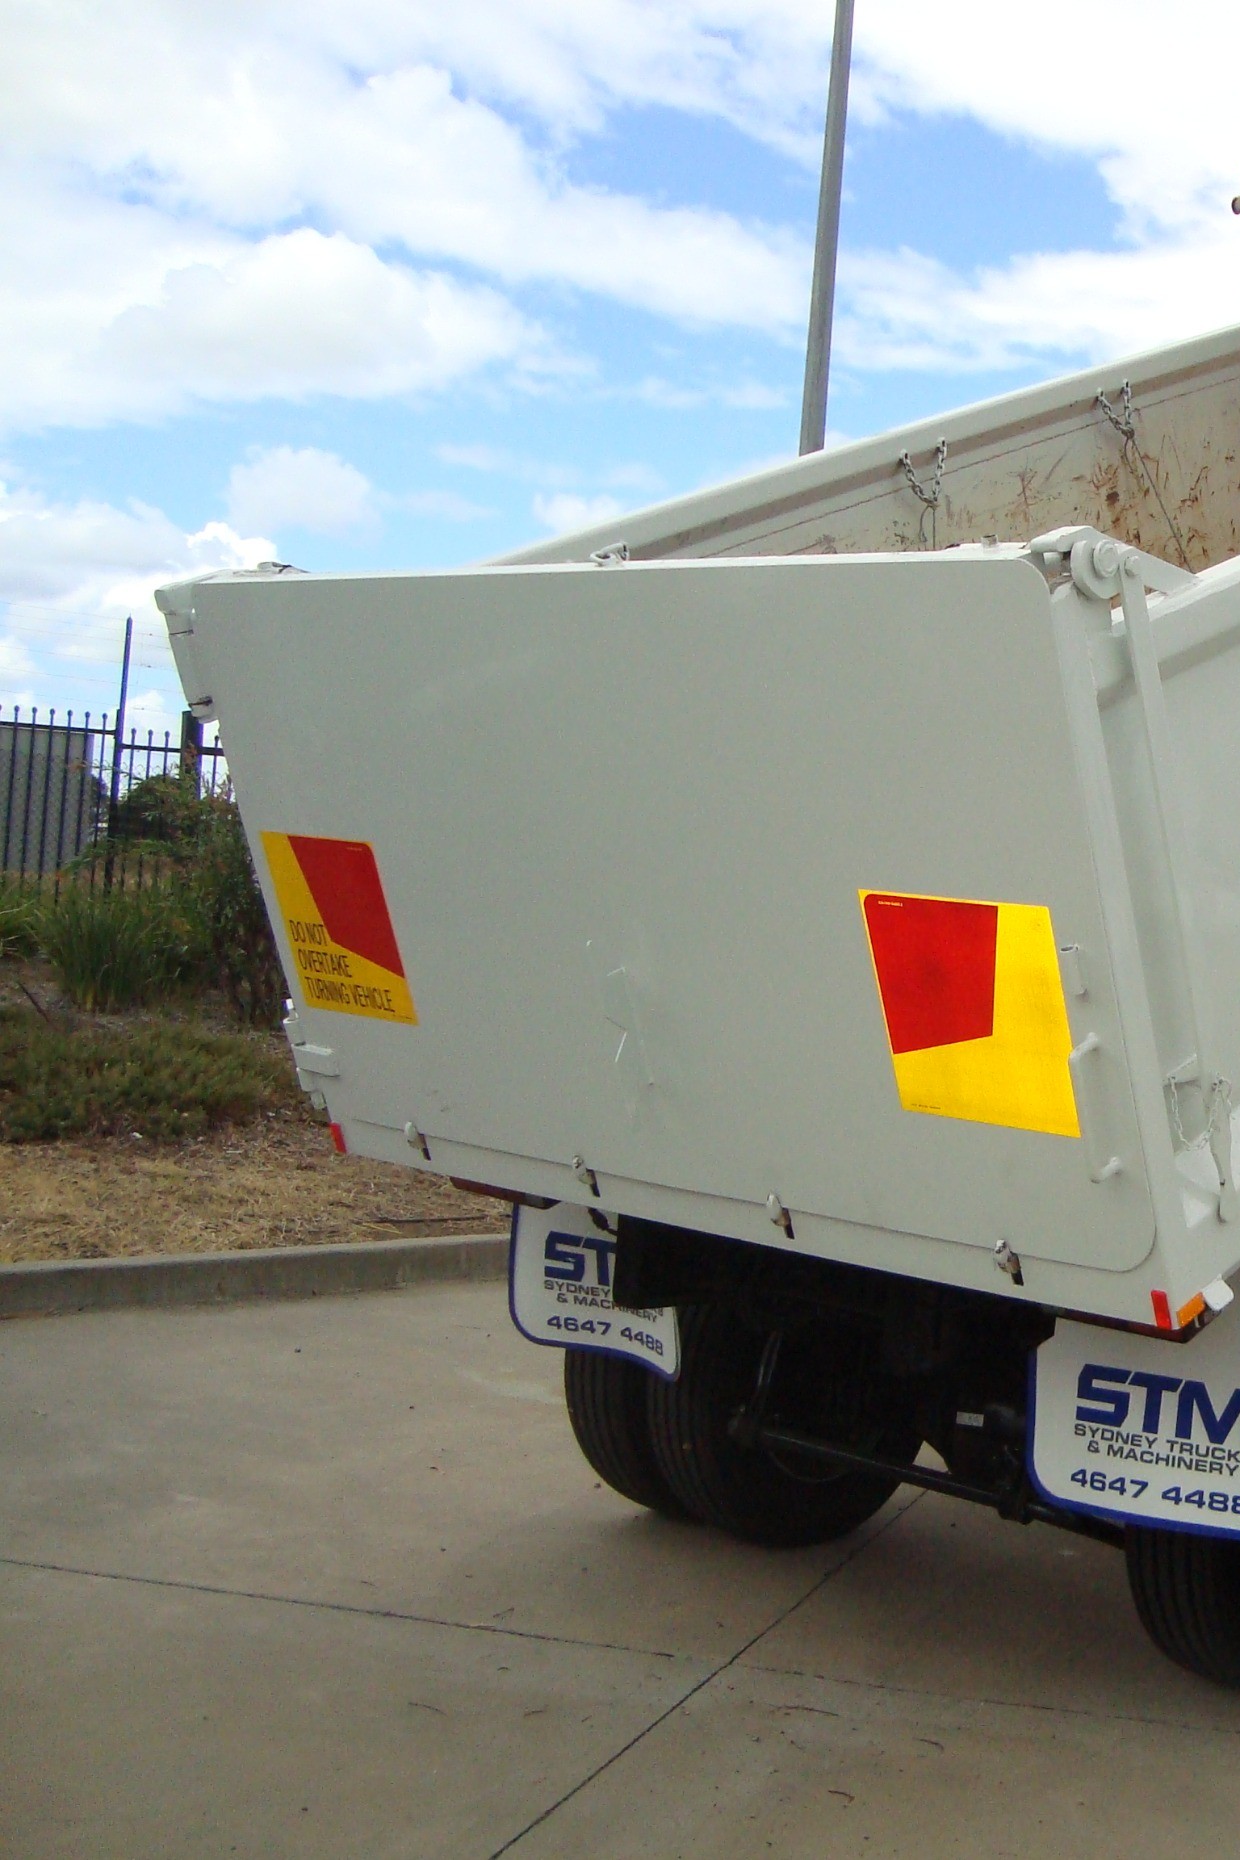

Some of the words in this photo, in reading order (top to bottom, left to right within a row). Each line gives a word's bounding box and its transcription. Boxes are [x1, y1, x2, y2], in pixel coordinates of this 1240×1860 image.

[289, 919, 306, 943] DO
[305, 922, 327, 947] NOT
[298, 948, 352, 978] OVERTAKE
[304, 976, 351, 1004] TURNING
[348, 983, 396, 1013] VEHICLE
[544, 1230, 618, 1287] ST
[544, 1280, 611, 1298] SYDNEY
[556, 1293, 568, 1304] &
[547, 1315, 611, 1336] 4647
[621, 1326, 664, 1356] 4488
[1074, 1423, 1158, 1449] SYDNEY
[1087, 1440, 1100, 1453] &
[1107, 1444, 1239, 1477] MACHINERY
[1070, 1468, 1149, 1499] 4647
